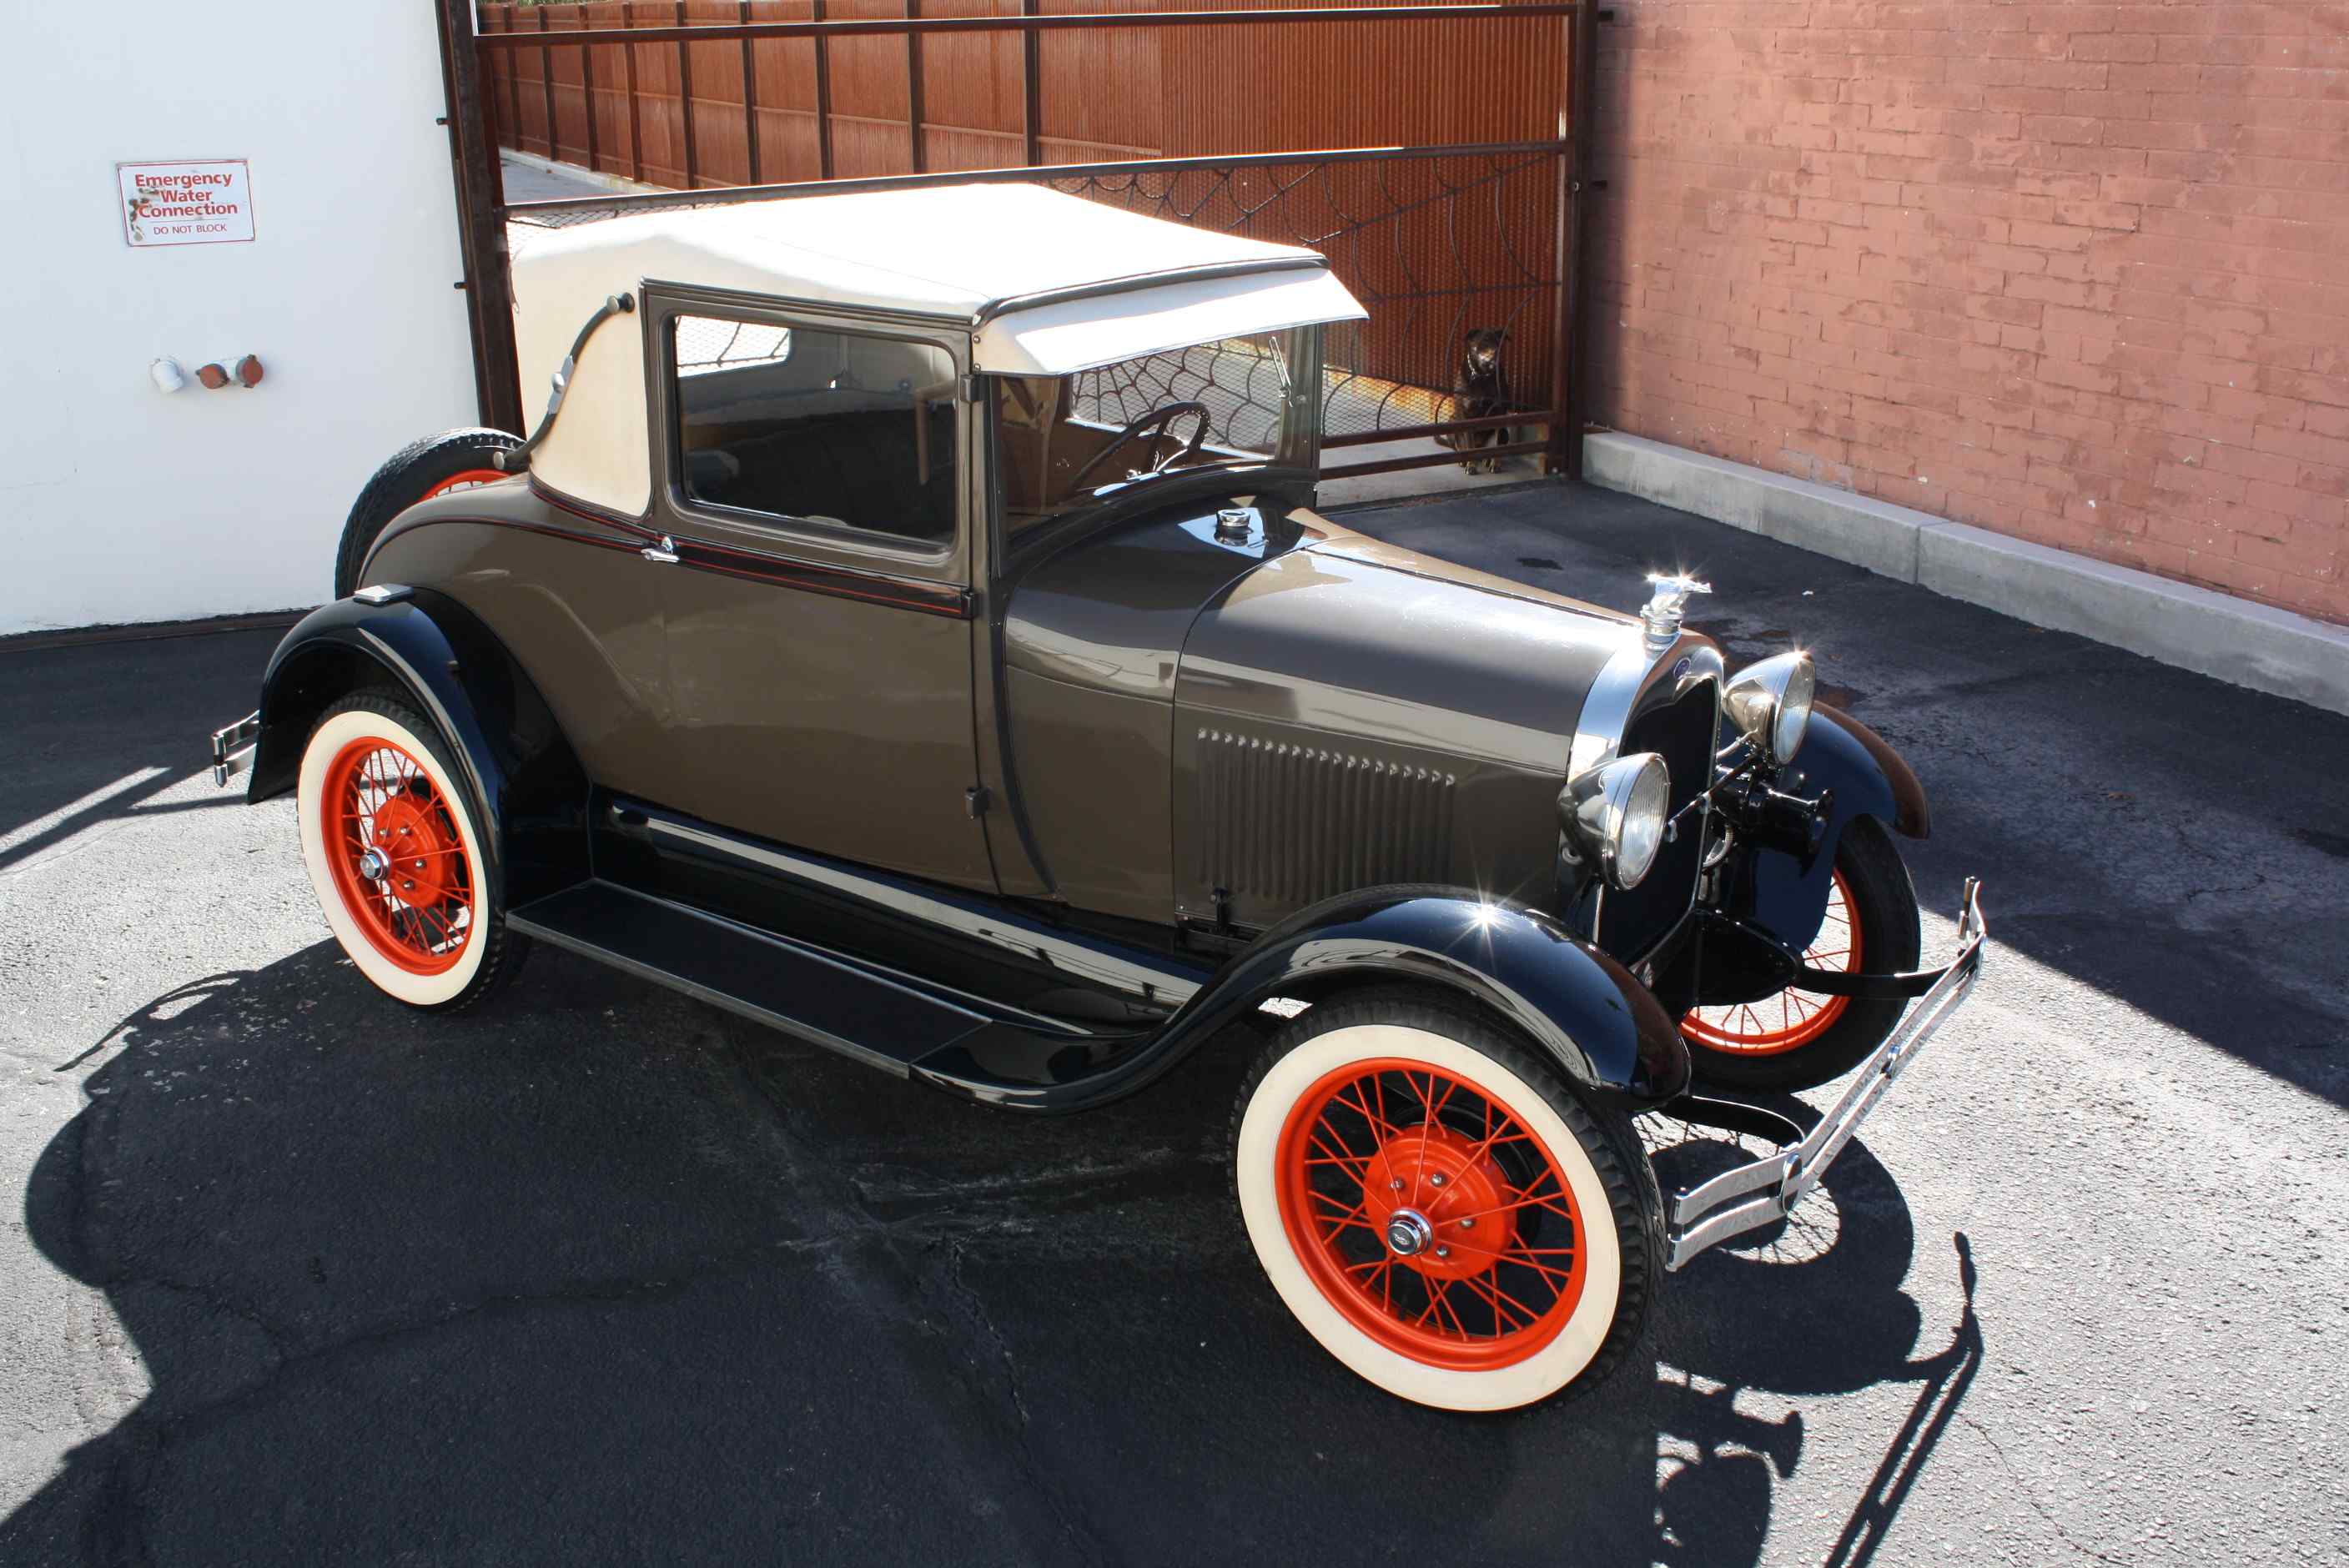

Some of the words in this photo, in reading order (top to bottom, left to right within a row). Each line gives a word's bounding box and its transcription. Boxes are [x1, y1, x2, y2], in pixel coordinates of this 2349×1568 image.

[135, 173, 232, 188] Emergency
[160, 190, 213, 203] Water
[138, 202, 238, 218] Connection
[153, 226, 169, 235] DO
[172, 225, 193, 234] NOT
[196, 224, 227, 234] BLOCK
